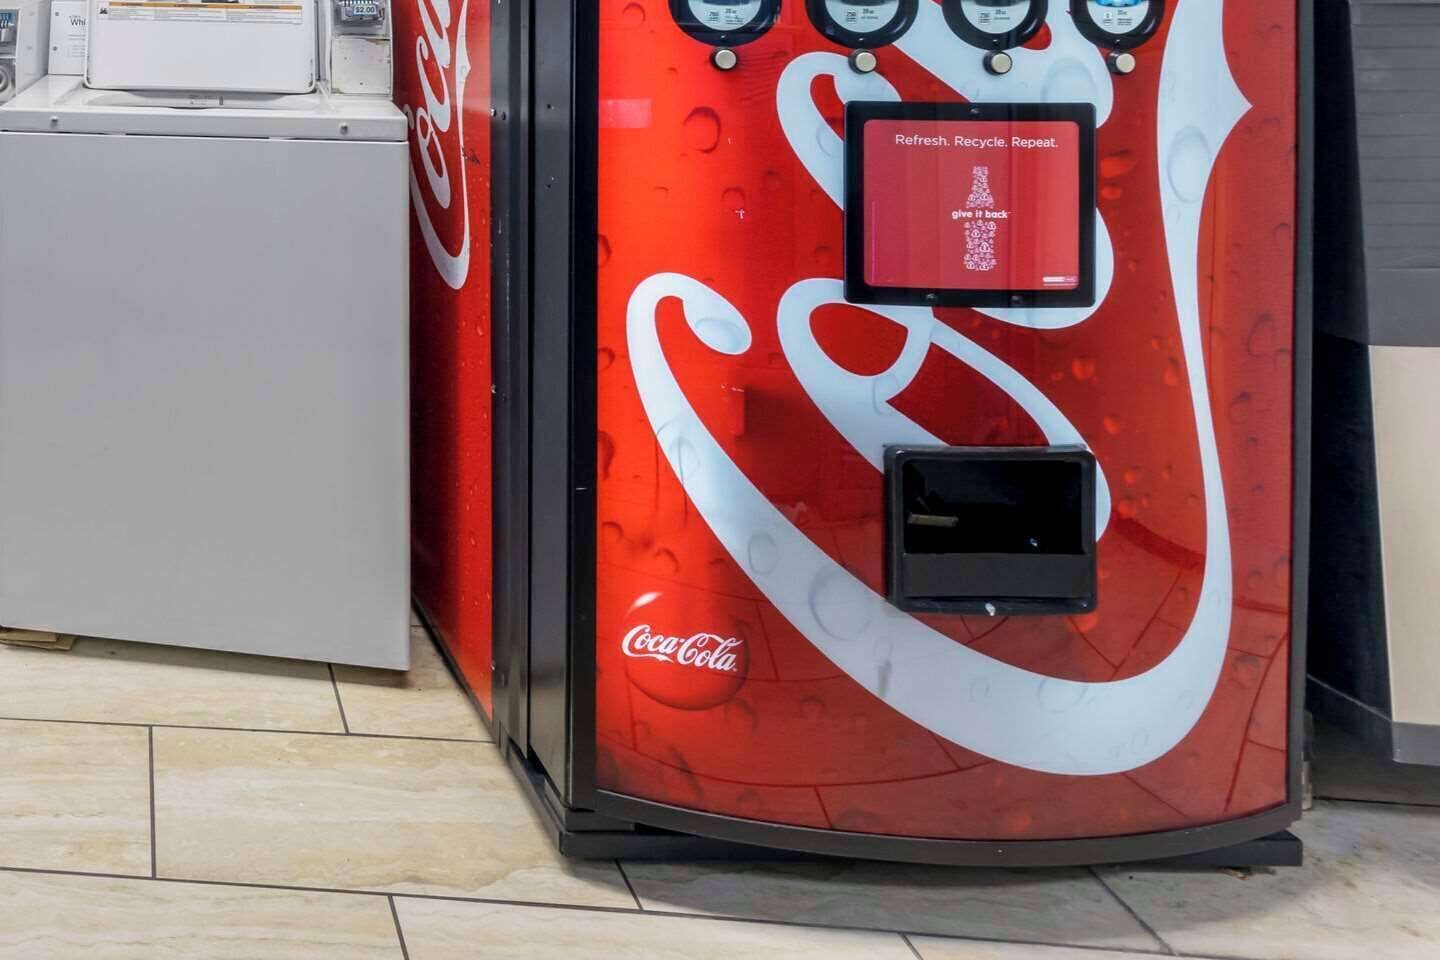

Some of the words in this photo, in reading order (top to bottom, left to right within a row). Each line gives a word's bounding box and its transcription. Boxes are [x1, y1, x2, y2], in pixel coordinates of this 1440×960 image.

[895, 134, 950, 146] Refresh.
[954, 135, 1008, 149] Recycle.
[1012, 136, 1059, 149] Repeat.
[952, 210, 973, 220] give
[975, 209, 983, 219] it
[985, 209, 1008, 219] back
[621, 624, 743, 672] Coca-Cola
